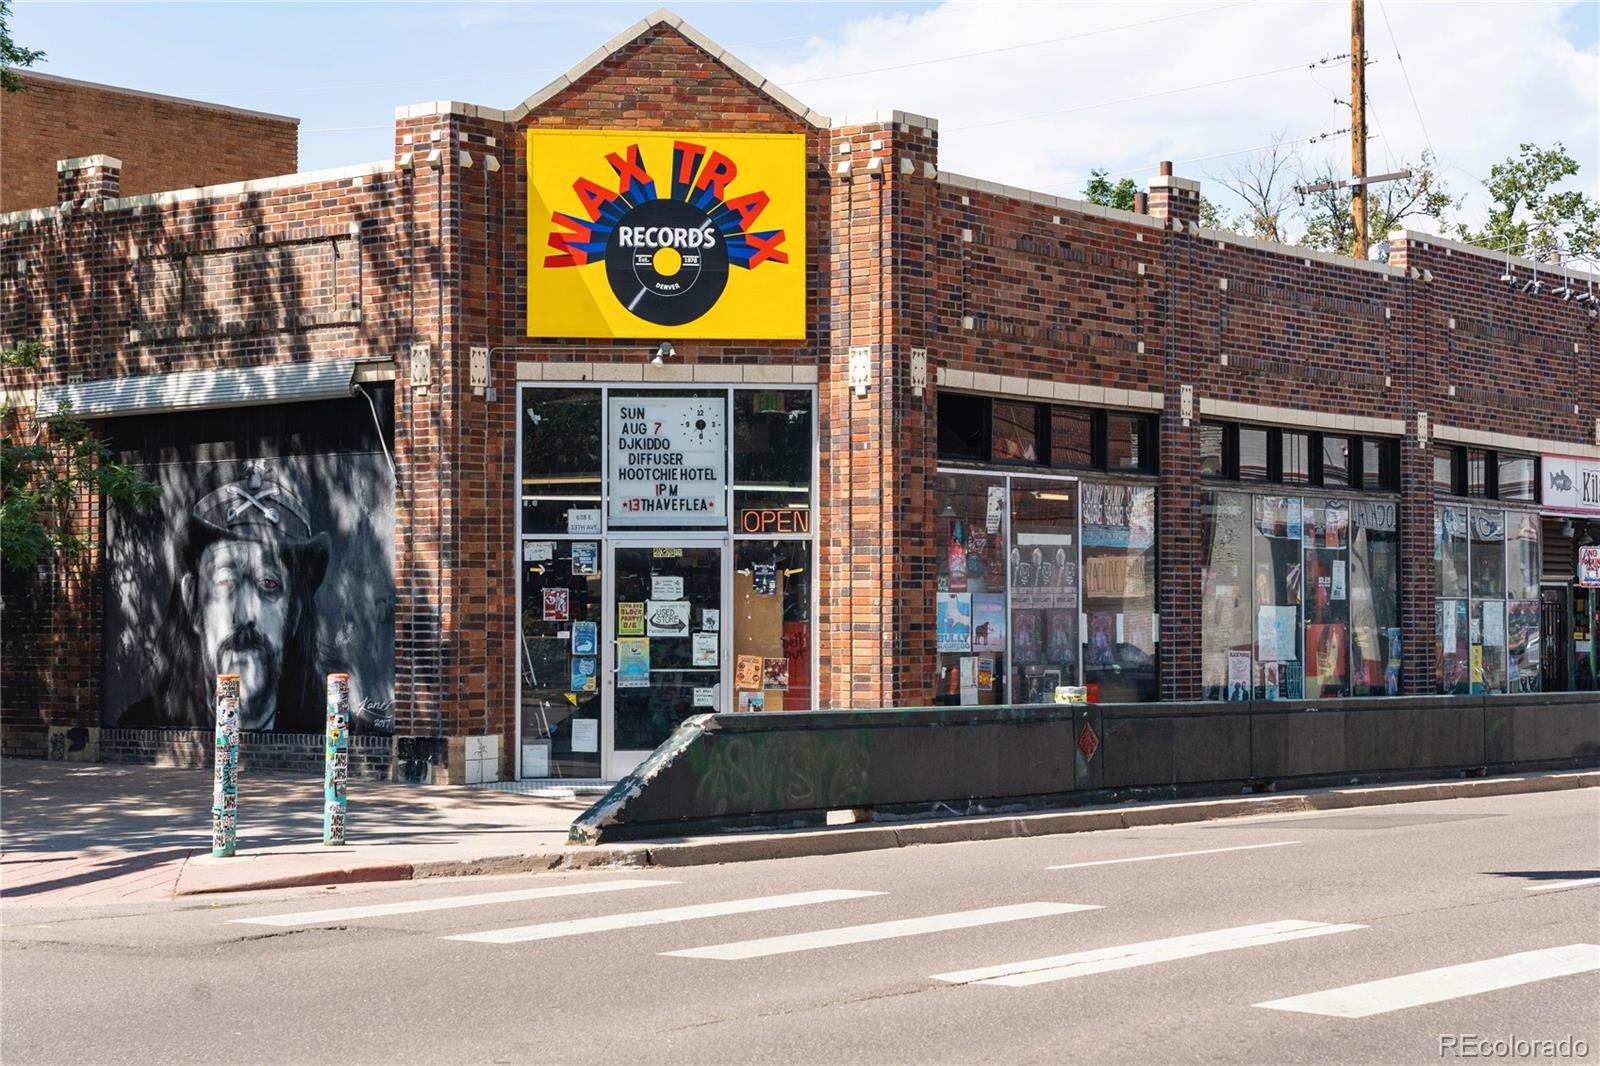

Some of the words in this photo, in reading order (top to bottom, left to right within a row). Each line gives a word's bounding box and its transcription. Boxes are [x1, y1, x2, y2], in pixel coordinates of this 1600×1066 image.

[544, 143, 655, 268] WAX
[672, 140, 789, 270] TRAX
[618, 225, 716, 249] RECORDS
[655, 282, 681, 291] DENVER
[620, 407, 645, 420] SUN
[622, 422, 647, 435] AUG
[654, 422, 662, 435] 7
[628, 453, 683, 466] DIFFUSER
[618, 468, 678, 481] HOOTCHIE
[680, 468, 717, 481] HOTEL
[1583, 471, 1600, 503] Kil
[743, 510, 809, 533] OPEN
[655, 615, 679, 623] STORE
